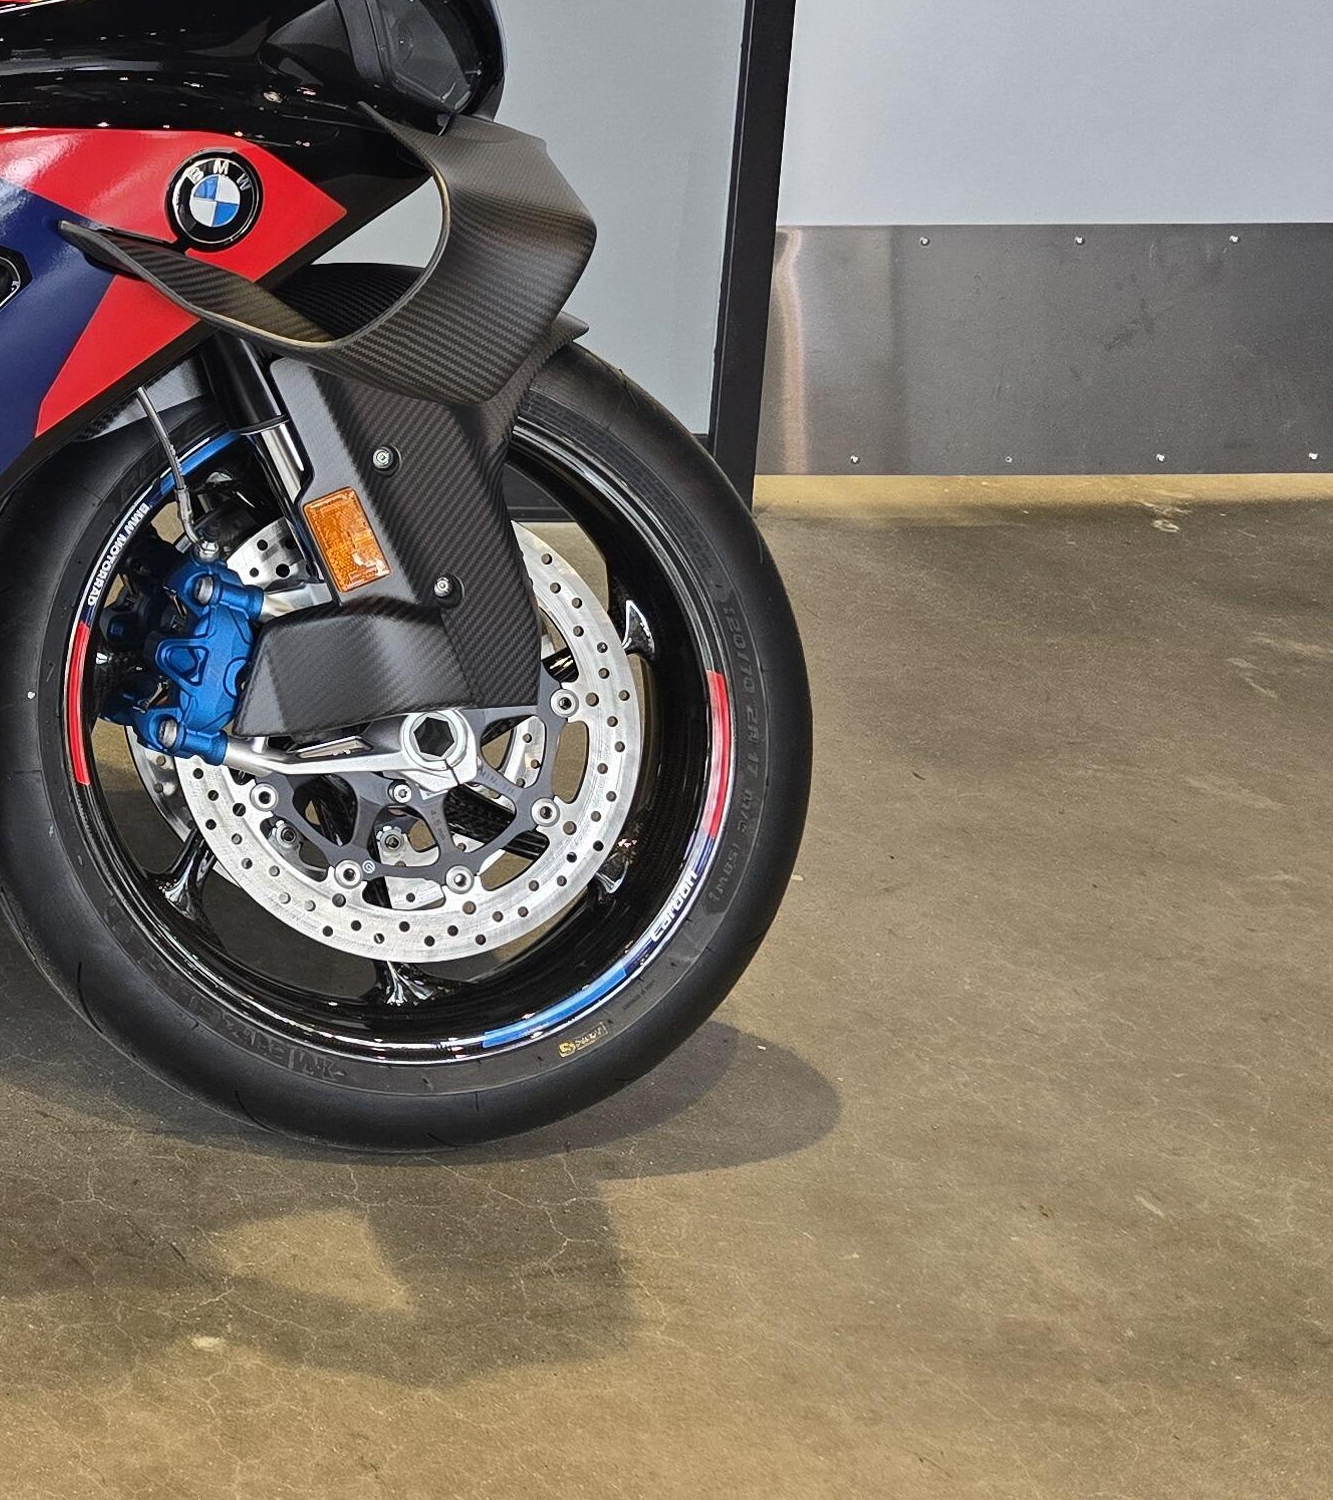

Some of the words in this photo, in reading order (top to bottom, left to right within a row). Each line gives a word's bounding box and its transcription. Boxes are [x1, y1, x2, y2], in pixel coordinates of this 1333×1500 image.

[186, 160, 252, 192] BMW
[124, 502, 150, 535] BMW
[87, 533, 127, 606] MOTORRAD
[649, 867, 698, 942] Carbon
